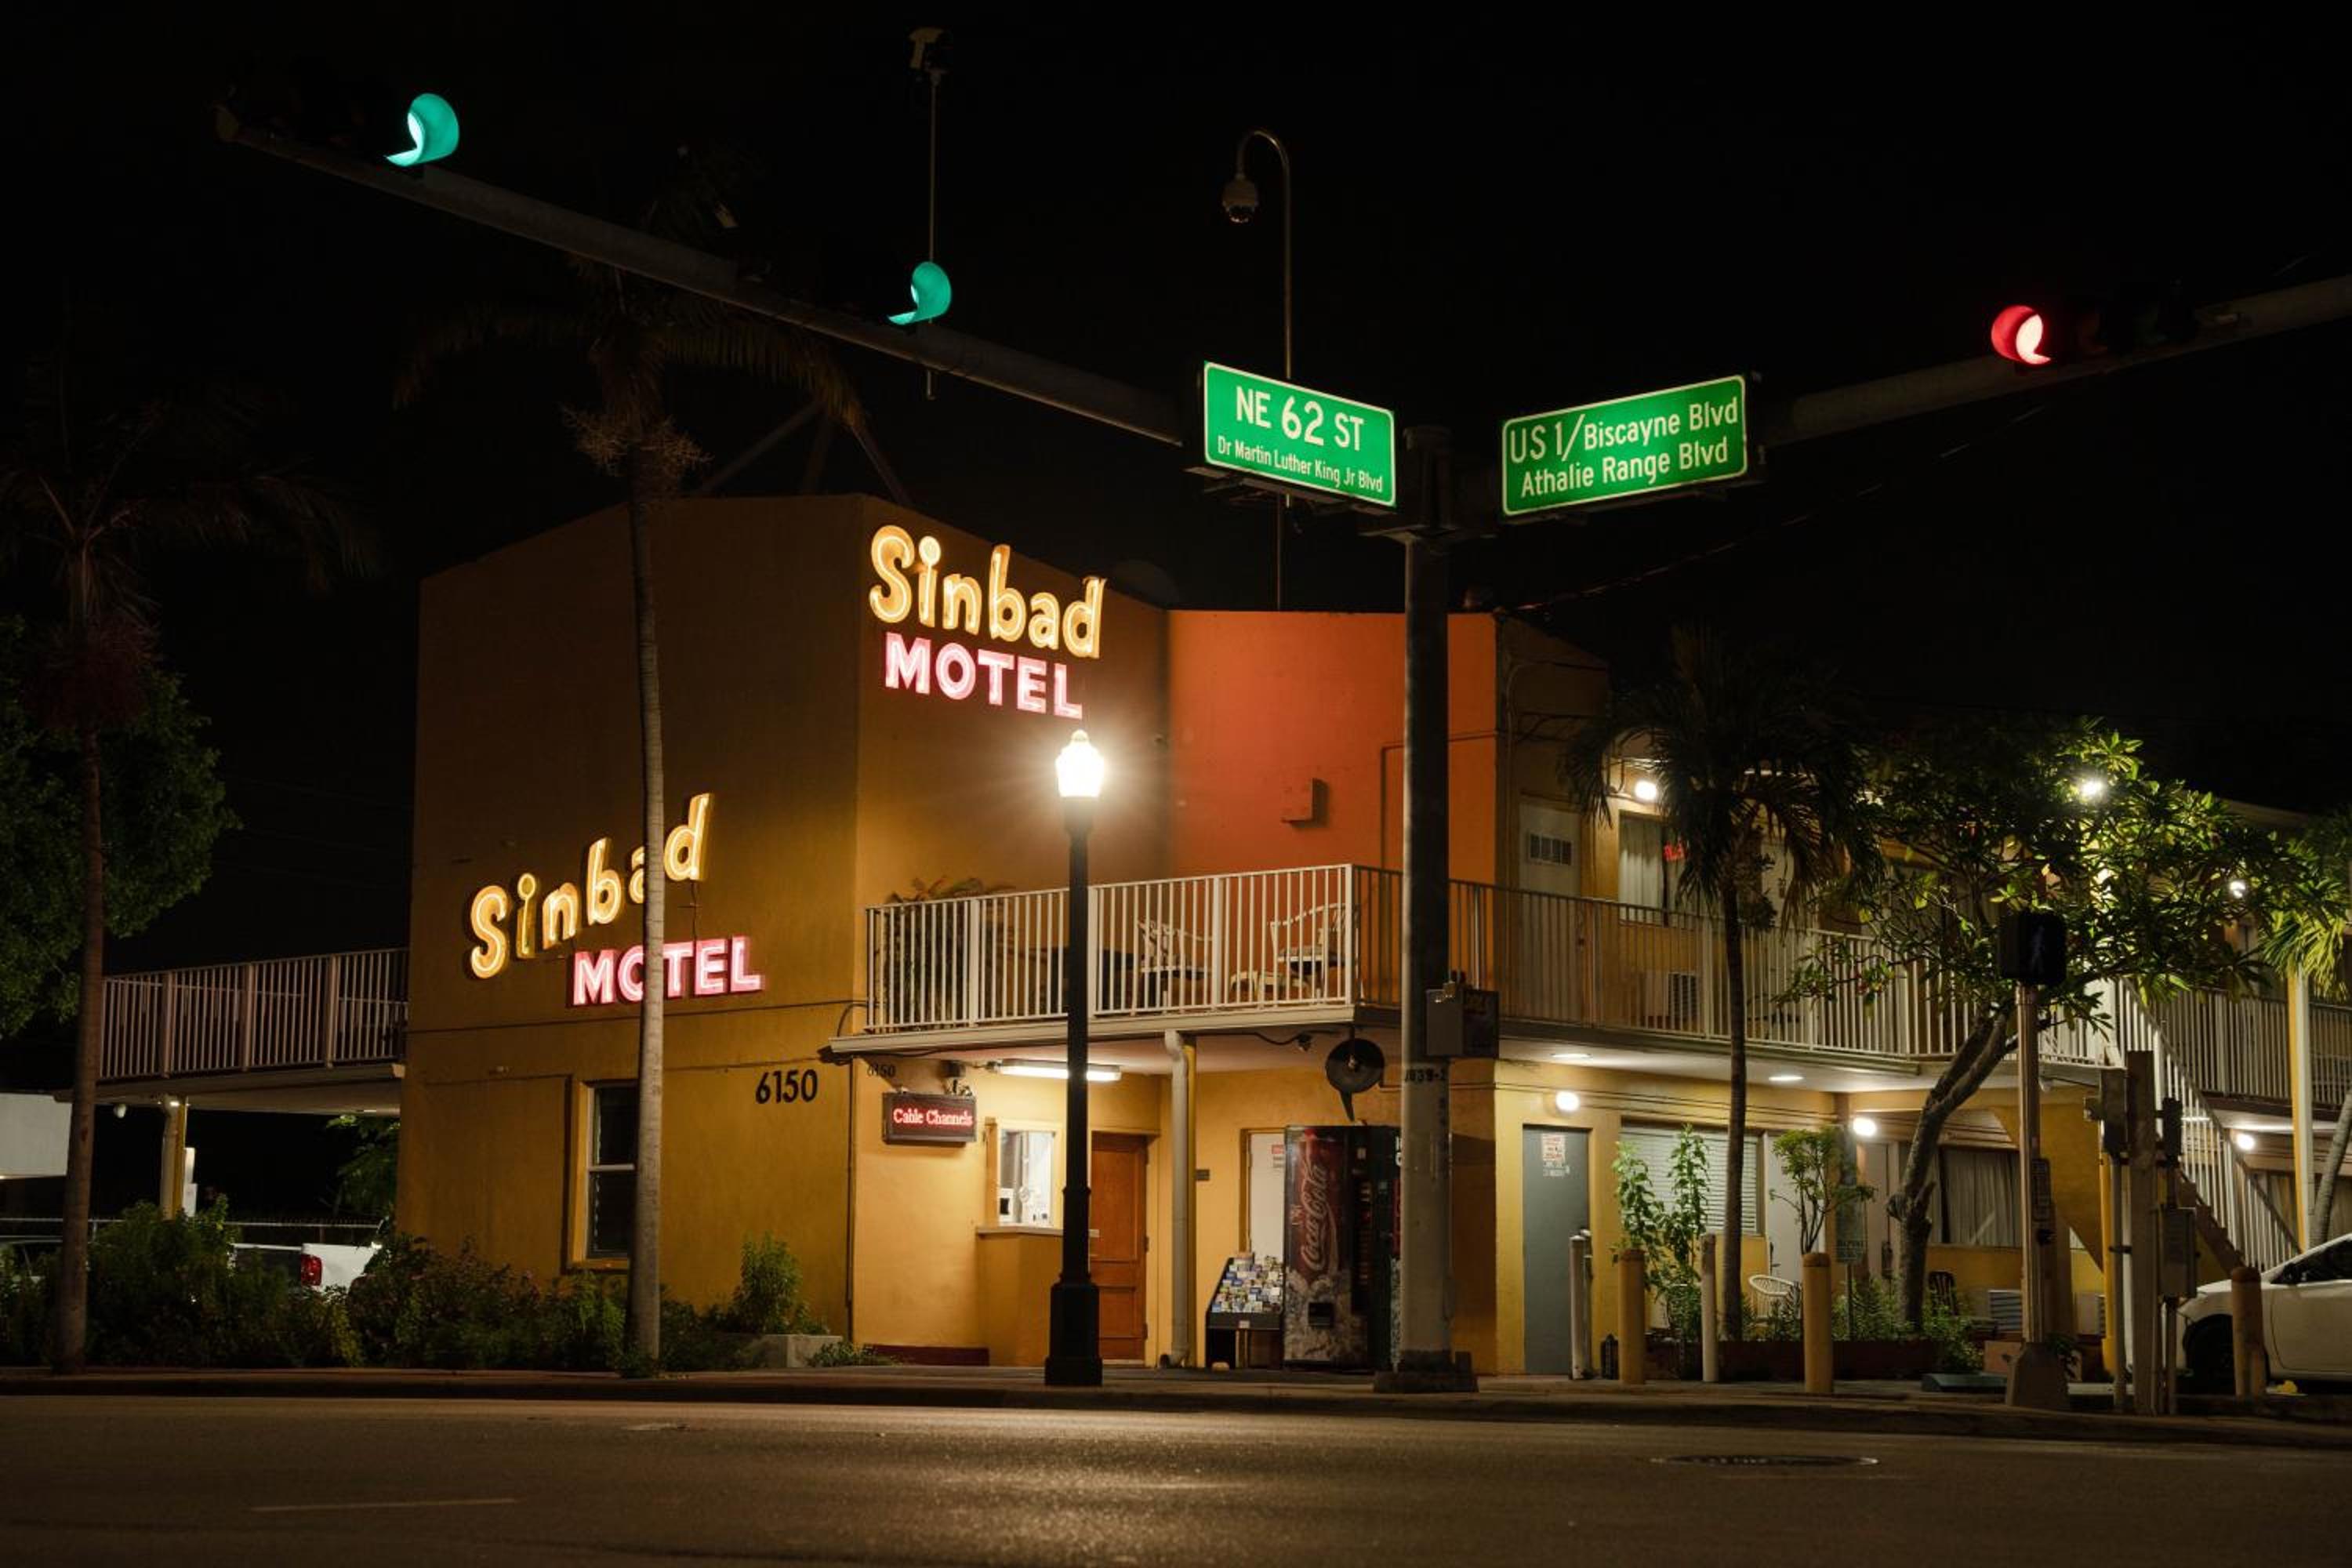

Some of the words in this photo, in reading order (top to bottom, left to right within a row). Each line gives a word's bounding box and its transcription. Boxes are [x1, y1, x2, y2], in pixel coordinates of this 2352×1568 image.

[1236, 385, 1272, 429] NE
[1282, 396, 1324, 446] 62
[1334, 412, 1363, 451] ST
[1510, 425, 1547, 463] US
[1690, 397, 1738, 432] Blvd
[1218, 435, 1232, 456] Dr
[1235, 439, 1272, 466] Martin
[1274, 449, 1312, 475] Luther
[1315, 459, 1340, 488] King
[1343, 467, 1356, 485] Jr
[1358, 470, 1383, 492] Blvd
[1521, 463, 1594, 498] Athalie
[1602, 452, 1671, 485] Range
[1679, 436, 1728, 470] Blvd
[869, 524, 1107, 659] Sinbad
[885, 631, 1083, 720] MOTEL
[755, 1069, 818, 1104] 6150
[894, 1108, 924, 1123] Cable
[926, 1109, 973, 1127] Channels
